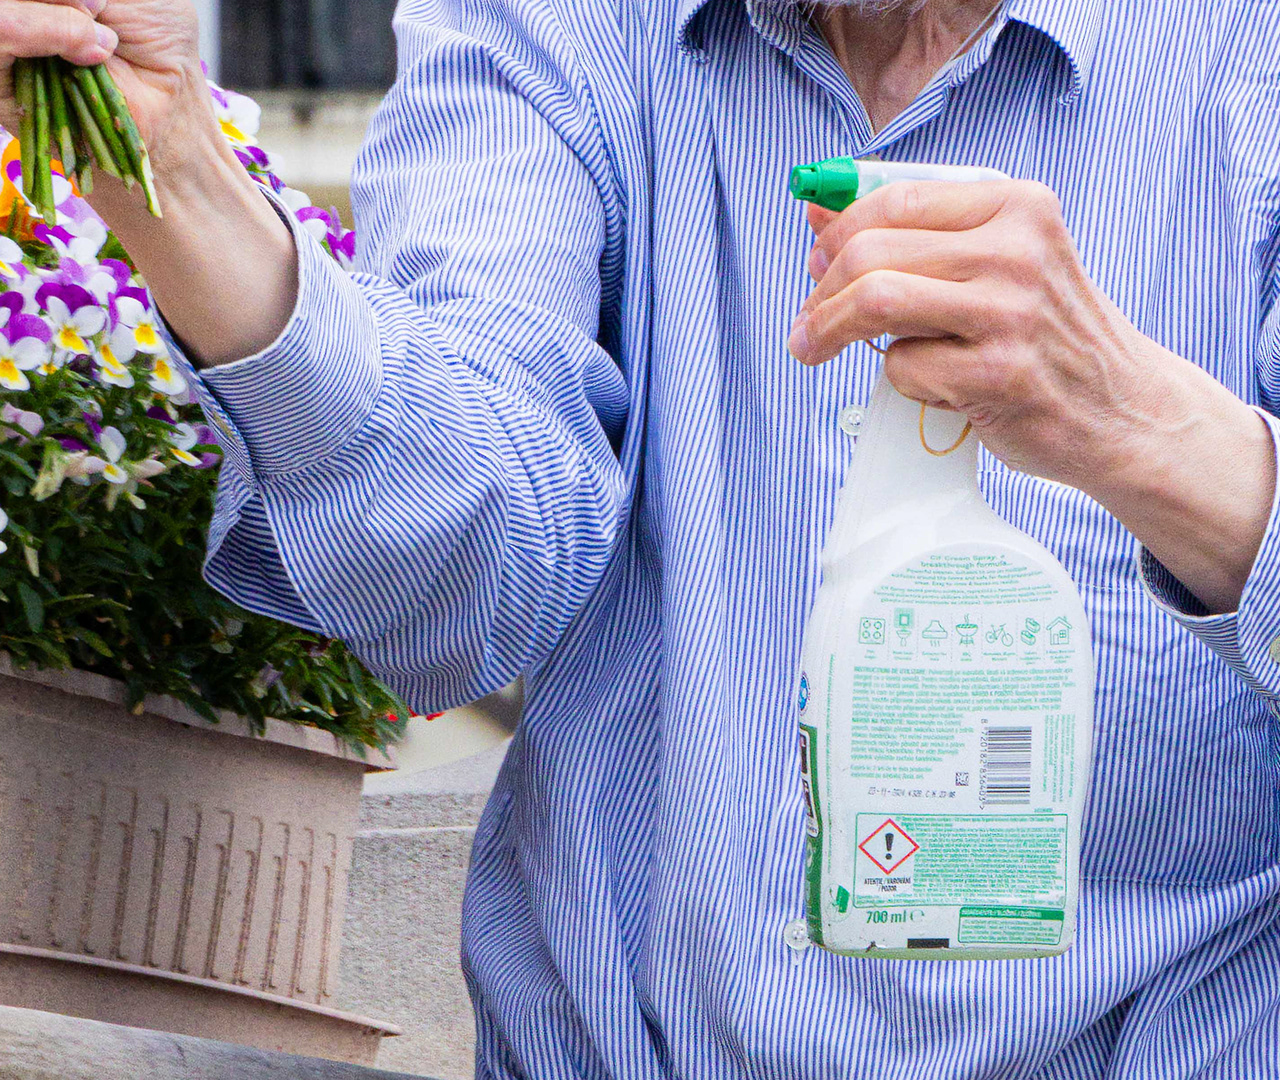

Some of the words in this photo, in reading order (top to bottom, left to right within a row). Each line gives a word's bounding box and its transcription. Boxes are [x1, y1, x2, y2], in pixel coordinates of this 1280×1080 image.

[920, 561, 975, 570] breakthrough
[866, 910, 889, 924] 700
[890, 909, 907, 923] ml
